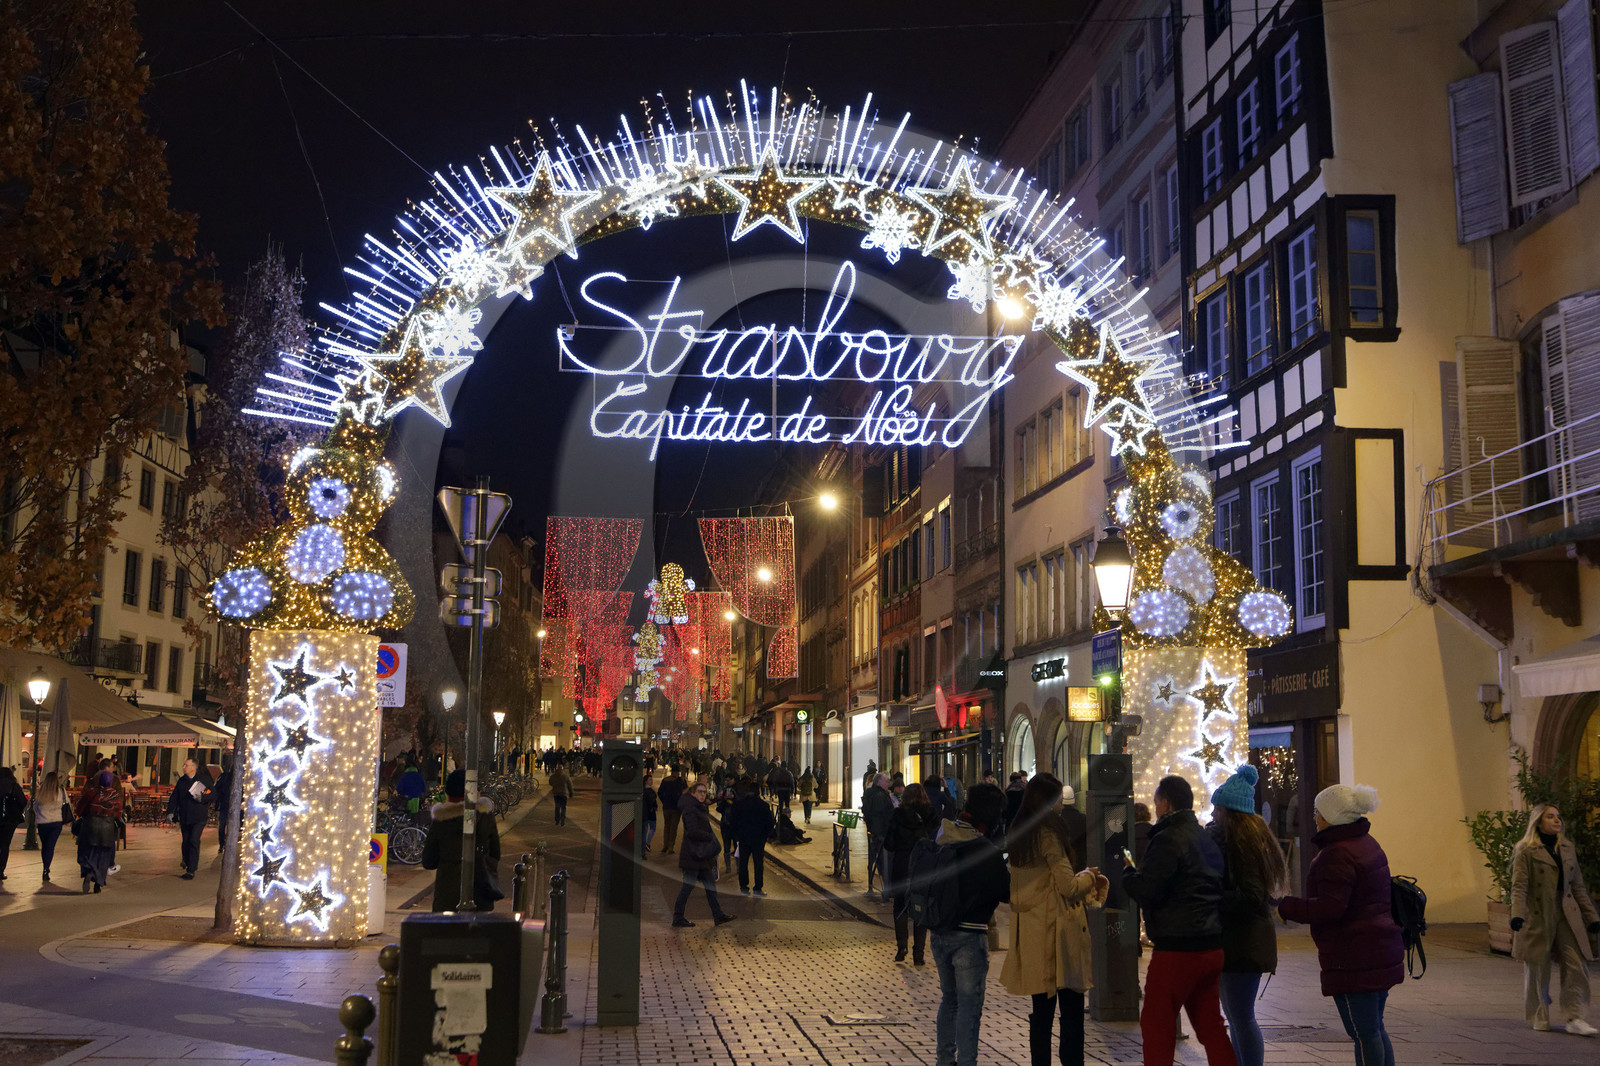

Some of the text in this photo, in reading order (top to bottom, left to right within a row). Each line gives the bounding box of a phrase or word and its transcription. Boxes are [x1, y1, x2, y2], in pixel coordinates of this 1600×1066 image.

[557, 260, 1026, 448] Strasbourg
[590, 382, 937, 461] Capitale de Noël
[1070, 701, 1100, 709] Jacques
[1271, 672, 1308, 696] PÂTISSERIE
[1312, 664, 1330, 689] CAFÉ
